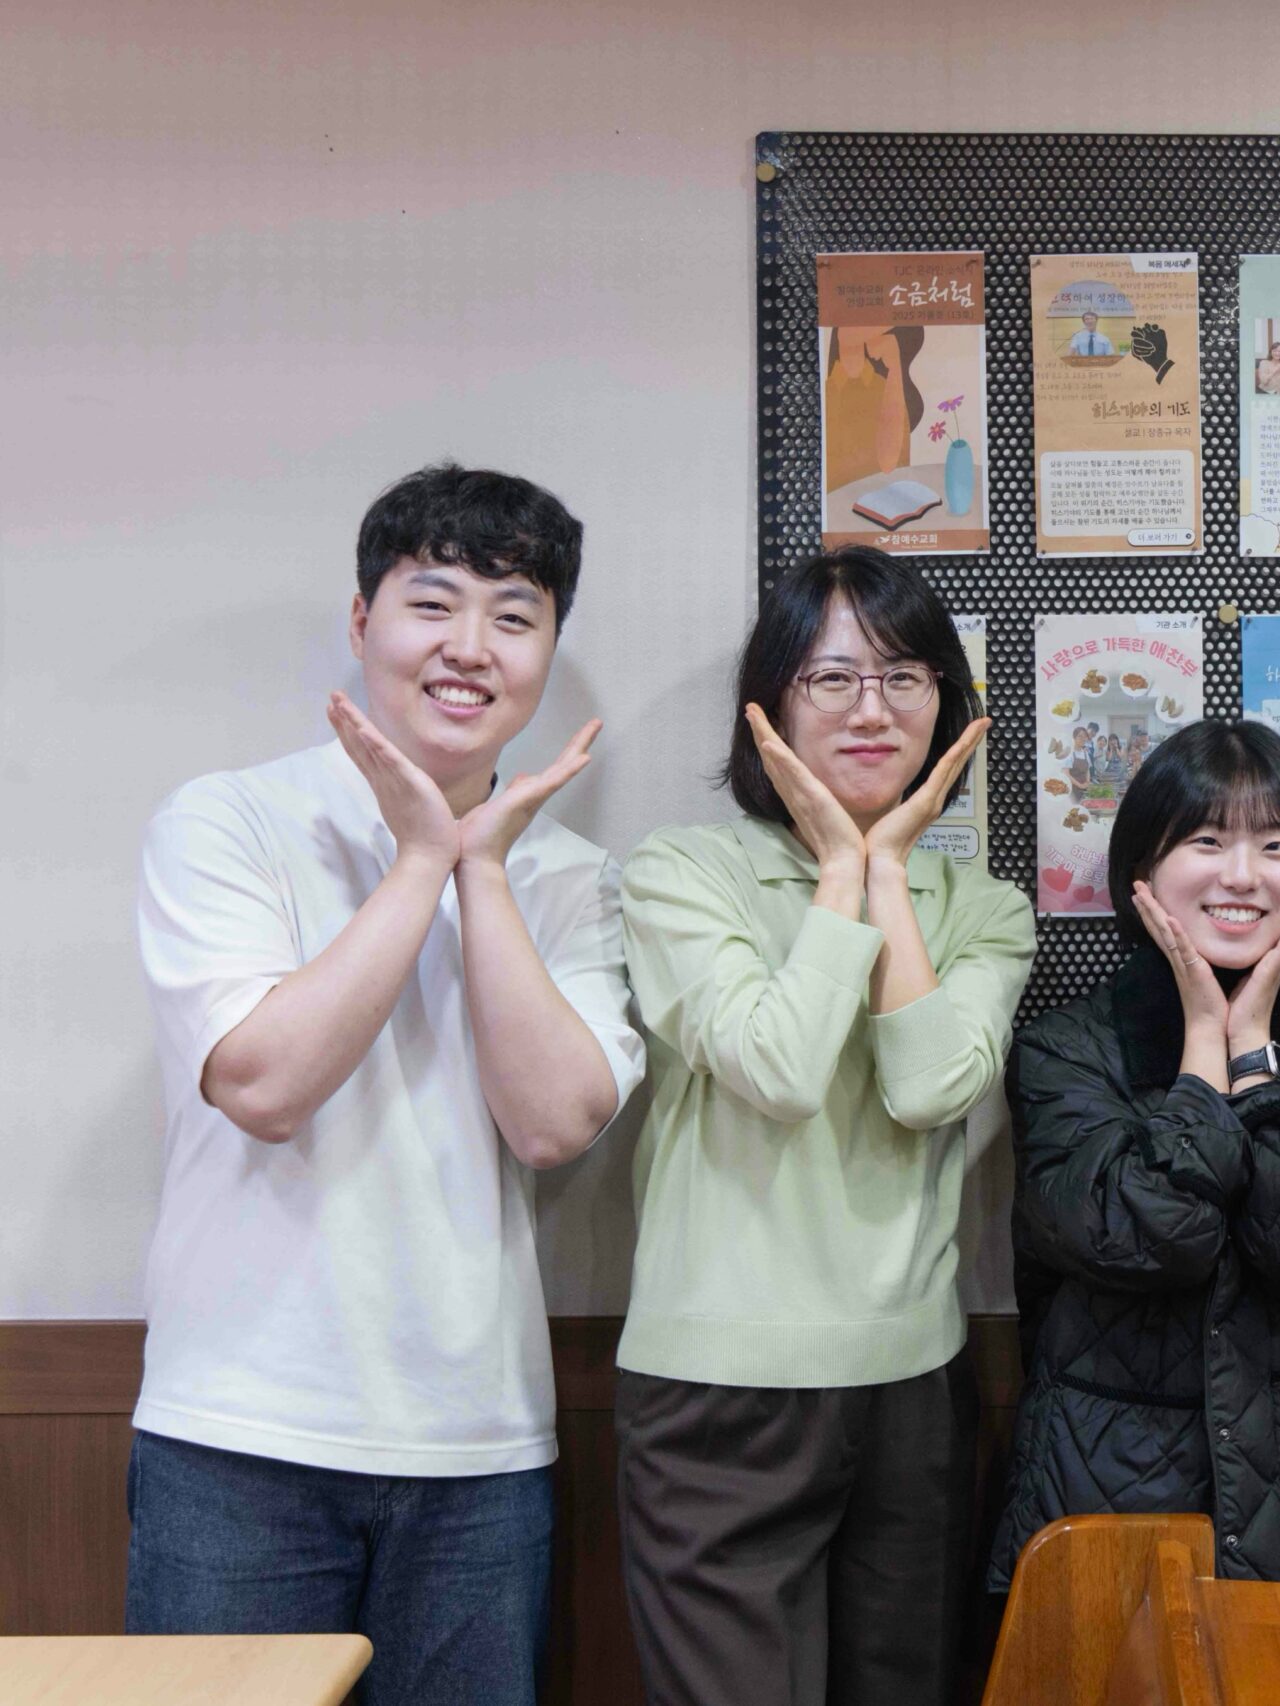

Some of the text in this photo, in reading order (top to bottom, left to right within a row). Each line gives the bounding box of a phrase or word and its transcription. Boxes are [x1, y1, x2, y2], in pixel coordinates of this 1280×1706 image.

[1148, 260, 1162, 269] 복음
[888, 275, 976, 309] 소금처럼
[1091, 401, 1191, 419] 히스기야의 기도
[1124, 428, 1141, 439] 설교
[891, 534, 938, 545] 참예수교회
[1138, 532, 1178, 543] 더 보러 가기
[1156, 621, 1187, 629] 기관 소개
[1040, 637, 1199, 681] 사랑으로 가득한 애찬부
[1071, 844, 1109, 868] 하나님
